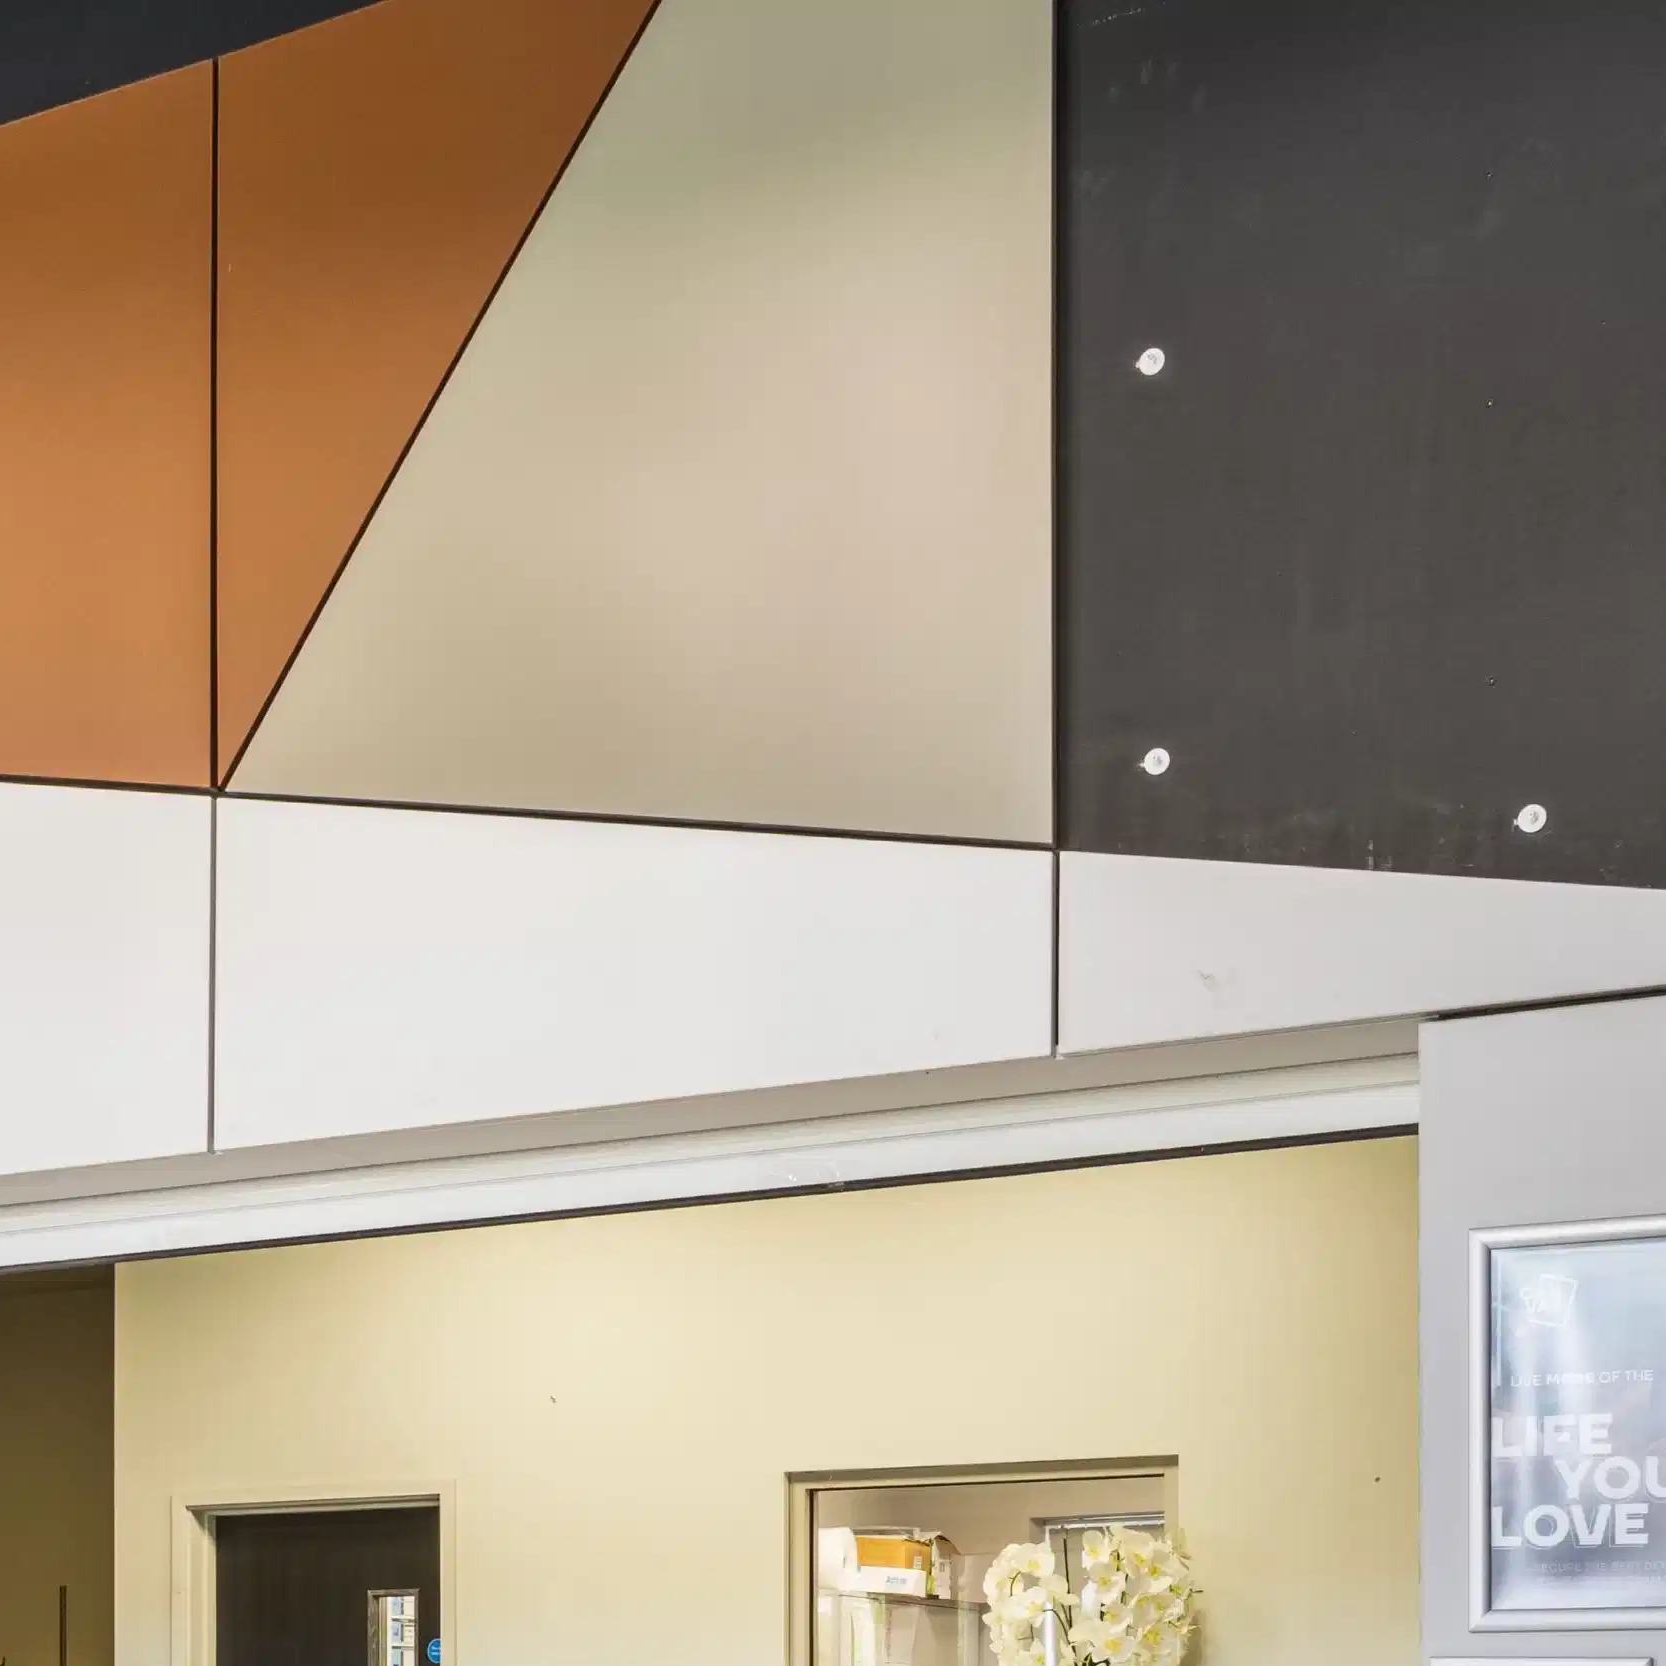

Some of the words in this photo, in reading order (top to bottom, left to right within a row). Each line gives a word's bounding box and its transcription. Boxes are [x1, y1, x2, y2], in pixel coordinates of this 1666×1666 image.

[1511, 1374, 1541, 1388] LIVE
[1598, 1371, 1621, 1384] OF
[1625, 1370, 1654, 1383] THE
[1492, 1413, 1613, 1458] LIFE
[1492, 1503, 1648, 1547] LOVE
